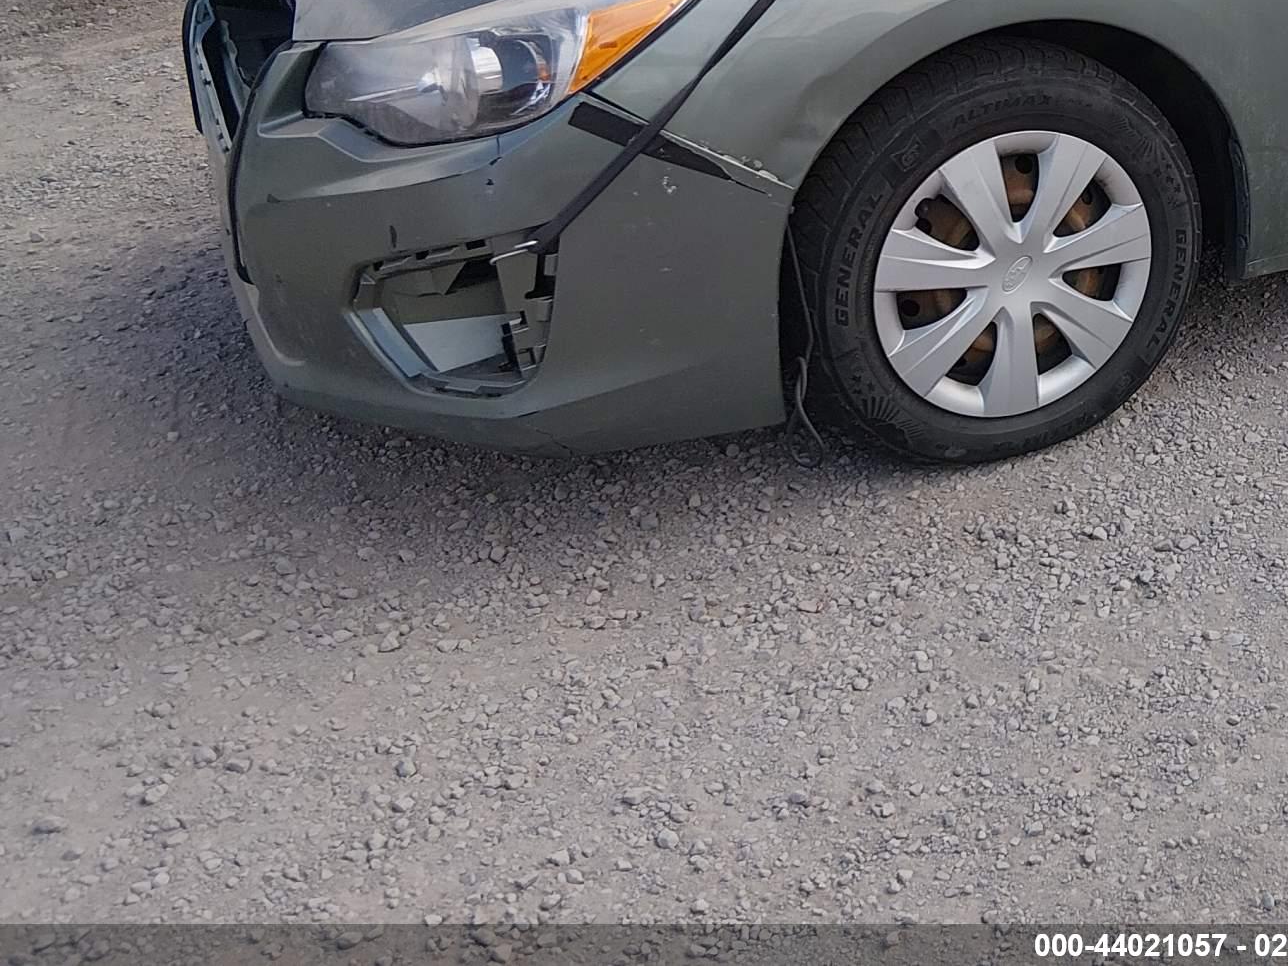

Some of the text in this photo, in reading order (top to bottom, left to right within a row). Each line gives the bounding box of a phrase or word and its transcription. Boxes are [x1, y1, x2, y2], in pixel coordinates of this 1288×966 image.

[951, 93, 1053, 130] ALTIMAX
[834, 192, 885, 327] GENERAL
[1146, 228, 1187, 352] GENERAL
